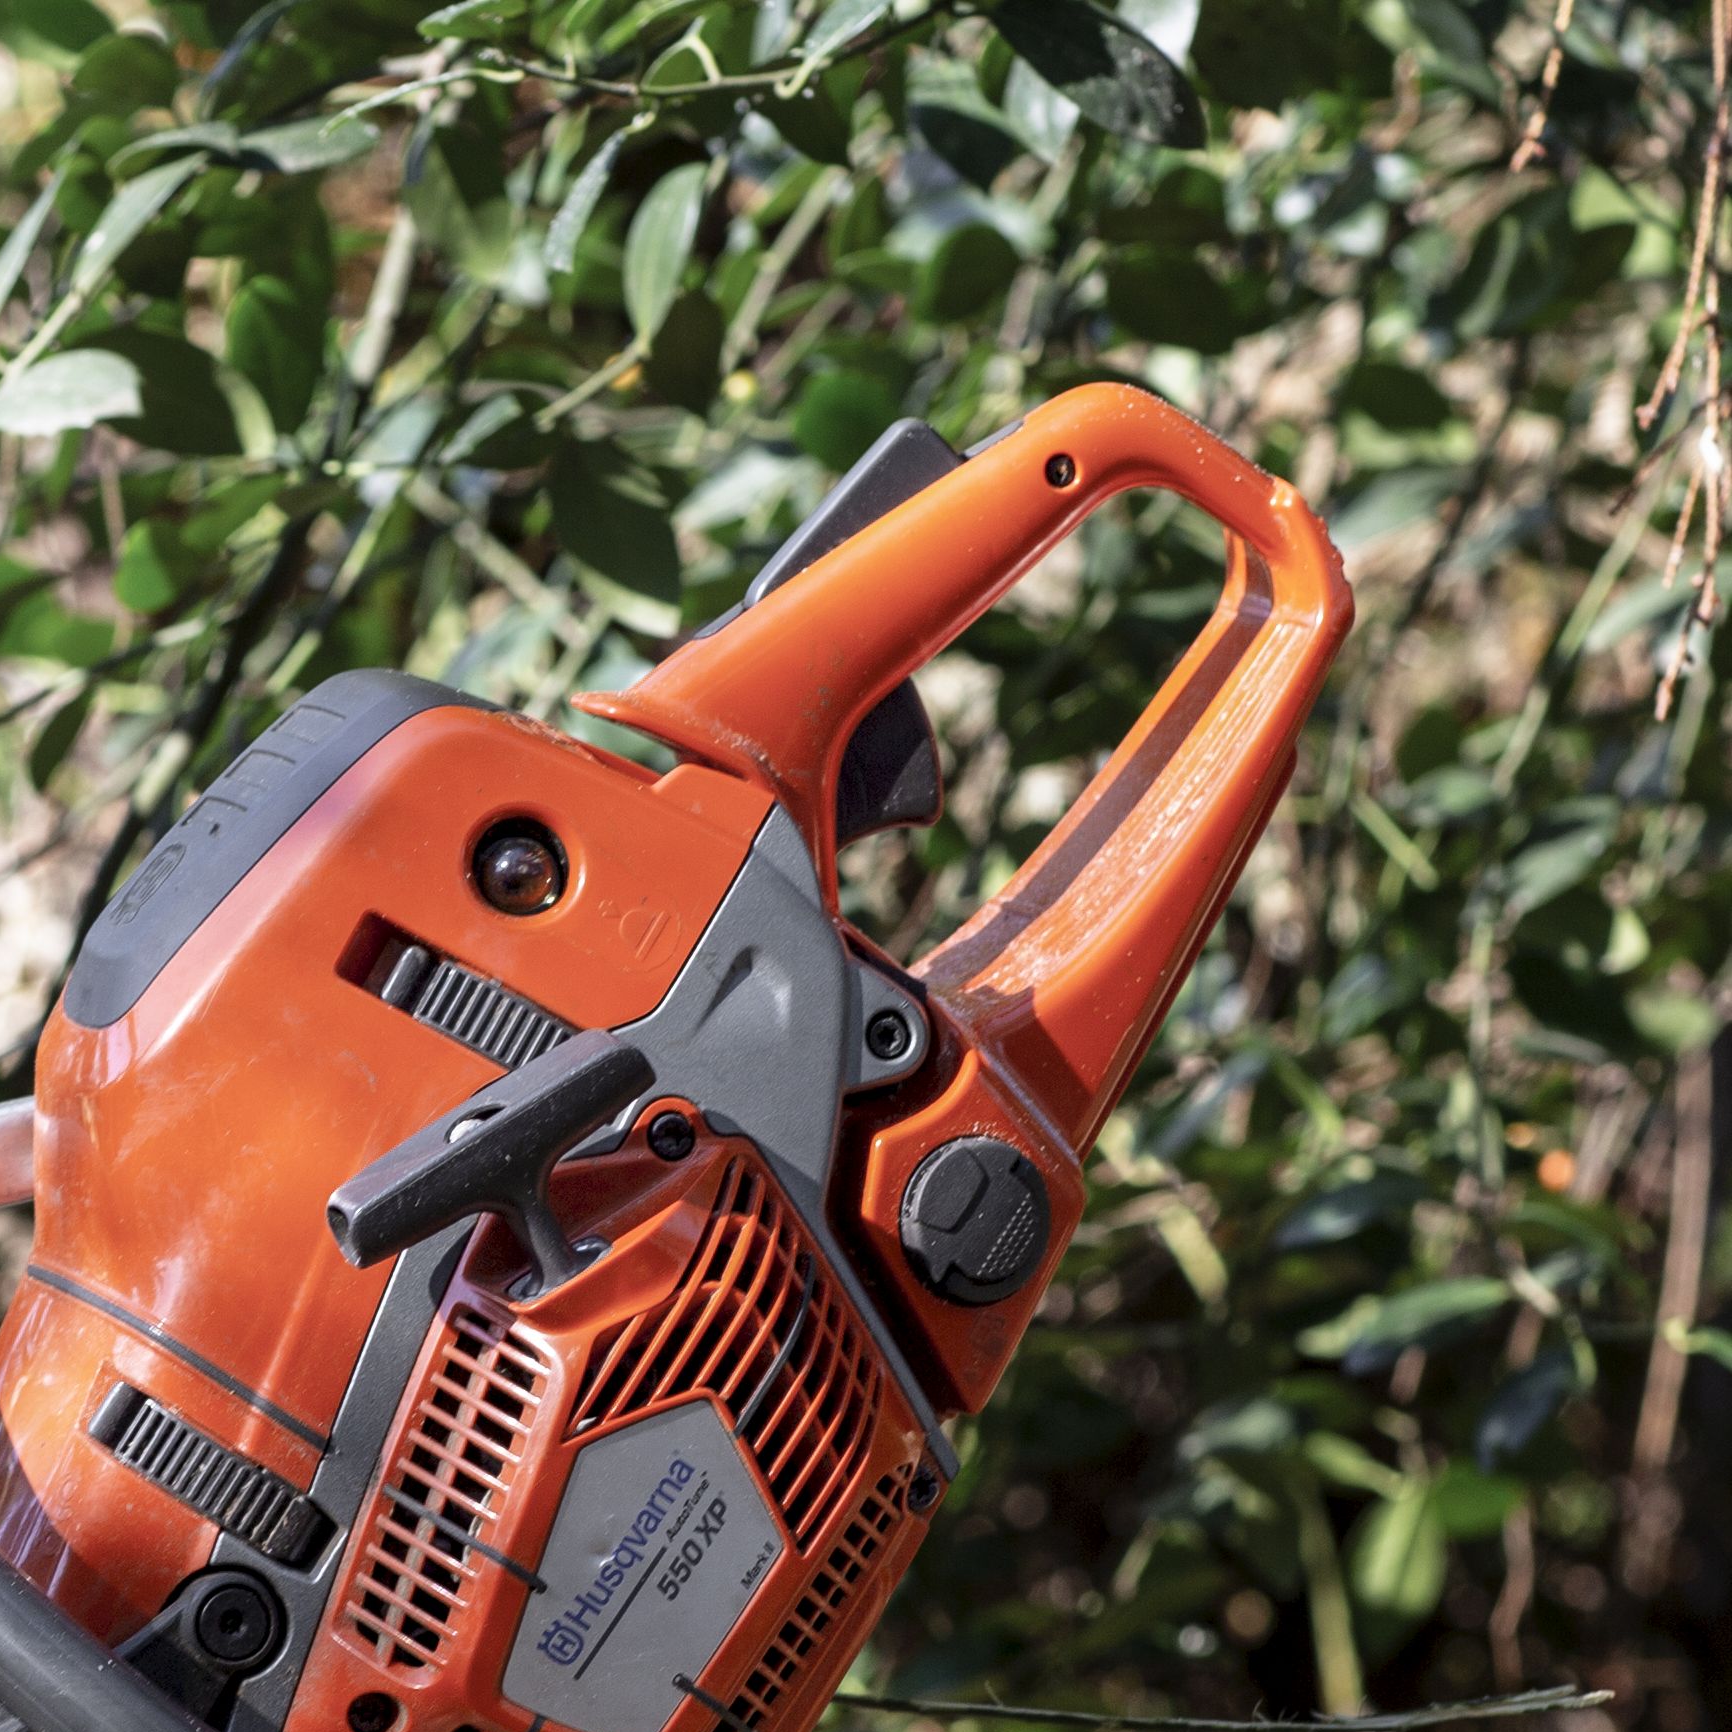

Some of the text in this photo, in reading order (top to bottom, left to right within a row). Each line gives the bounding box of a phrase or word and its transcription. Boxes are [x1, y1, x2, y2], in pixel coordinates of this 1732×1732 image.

[564, 1458, 695, 1631] Husqvarna
[657, 1497, 727, 1601] 550 XP
[740, 1552, 768, 1590] Mark
